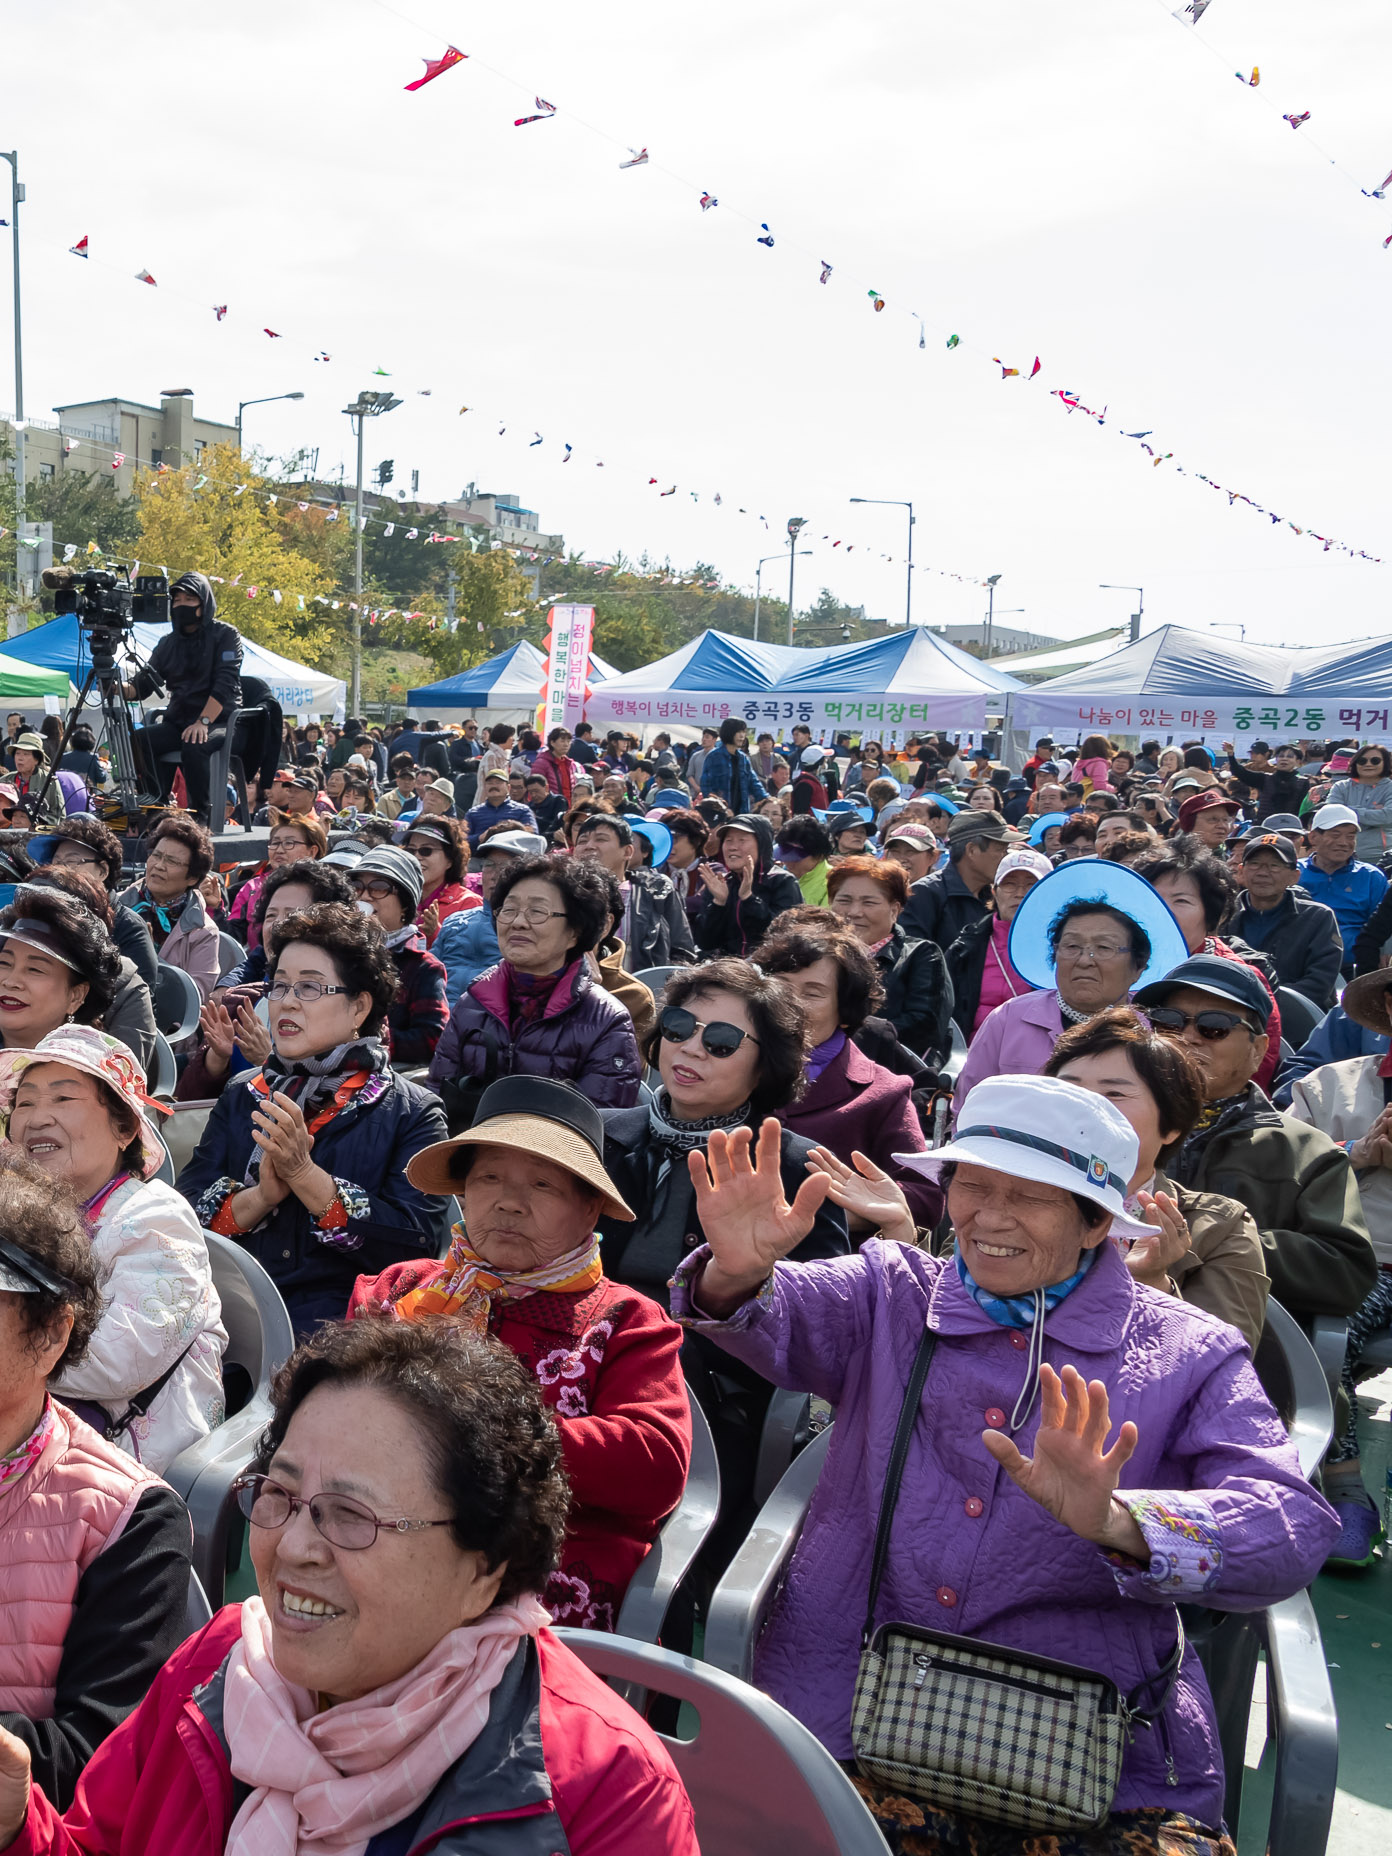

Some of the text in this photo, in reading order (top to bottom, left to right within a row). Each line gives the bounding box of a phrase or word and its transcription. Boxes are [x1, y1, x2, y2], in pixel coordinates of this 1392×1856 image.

[272, 686, 314, 707] 거리장터
[610, 699, 929, 724] 행복이 넘치는 마을 중곡3동 먹거리장터
[1078, 706, 1132, 726] 나눔이
[1138, 708, 1175, 728] 있는
[1181, 709, 1219, 729] 마을
[1232, 707, 1326, 732] 중곡2동
